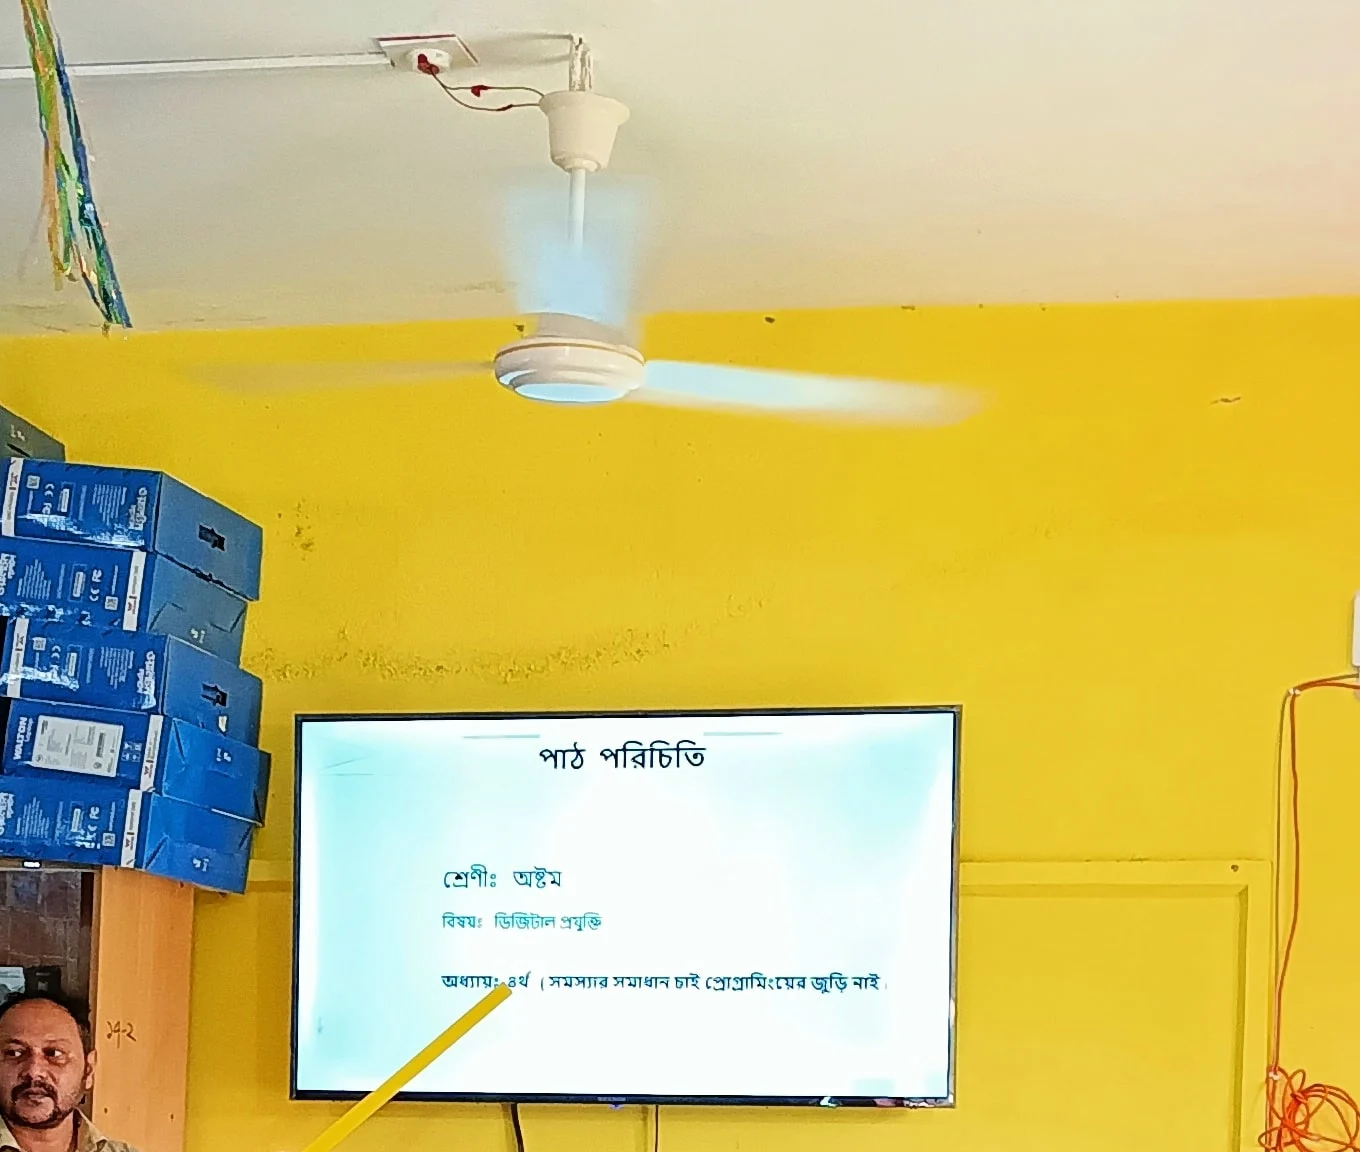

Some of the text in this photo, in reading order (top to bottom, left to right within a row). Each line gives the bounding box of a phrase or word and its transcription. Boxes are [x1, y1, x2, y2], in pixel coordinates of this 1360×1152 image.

[13, 716, 28, 760] WALTON
[539, 739, 707, 770] পাঠ পরিচিতি
[513, 866, 562, 888] অষ্টম
[494, 912, 556, 930] ডিজিটাল
[560, 912, 602, 931] প্রযুক্তি
[507, 971, 532, 988] ৪র্থ
[612, 976, 670, 989] সমাধান
[674, 972, 700, 990] চাই
[705, 971, 807, 991] প্রোগ্রামিংয়ের
[811, 971, 848, 994] জুড়ি
